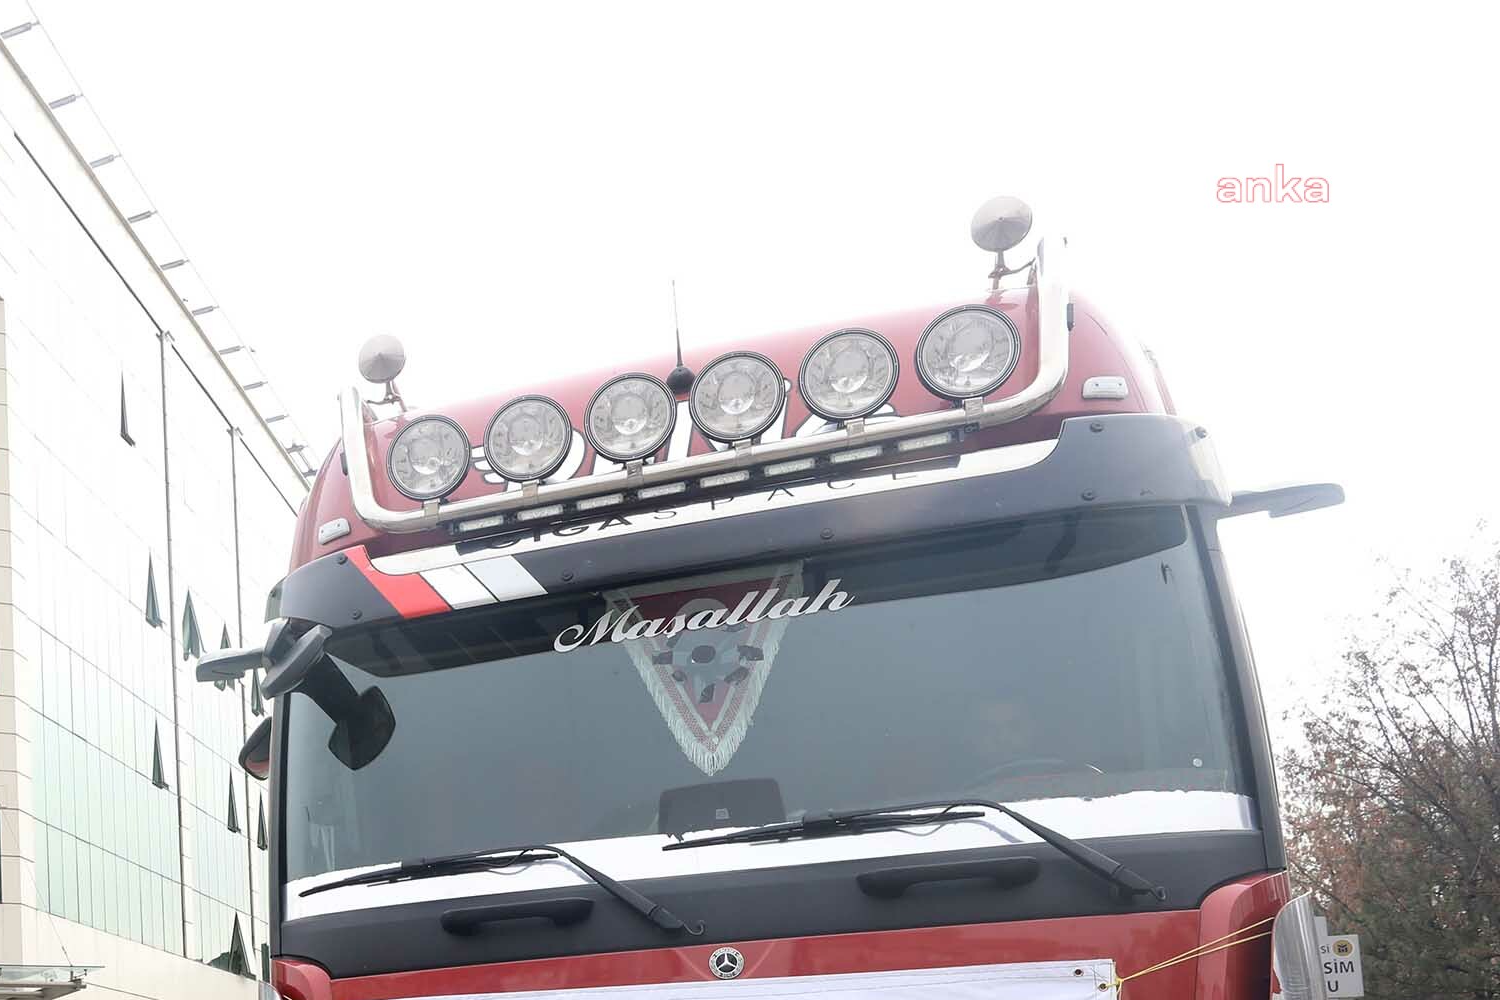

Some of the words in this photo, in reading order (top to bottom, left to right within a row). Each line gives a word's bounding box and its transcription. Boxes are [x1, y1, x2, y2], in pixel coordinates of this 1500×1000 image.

[553, 578, 855, 653] Maşallah
[1323, 959, 1354, 974] SİM
[1327, 980, 1339, 992] U
